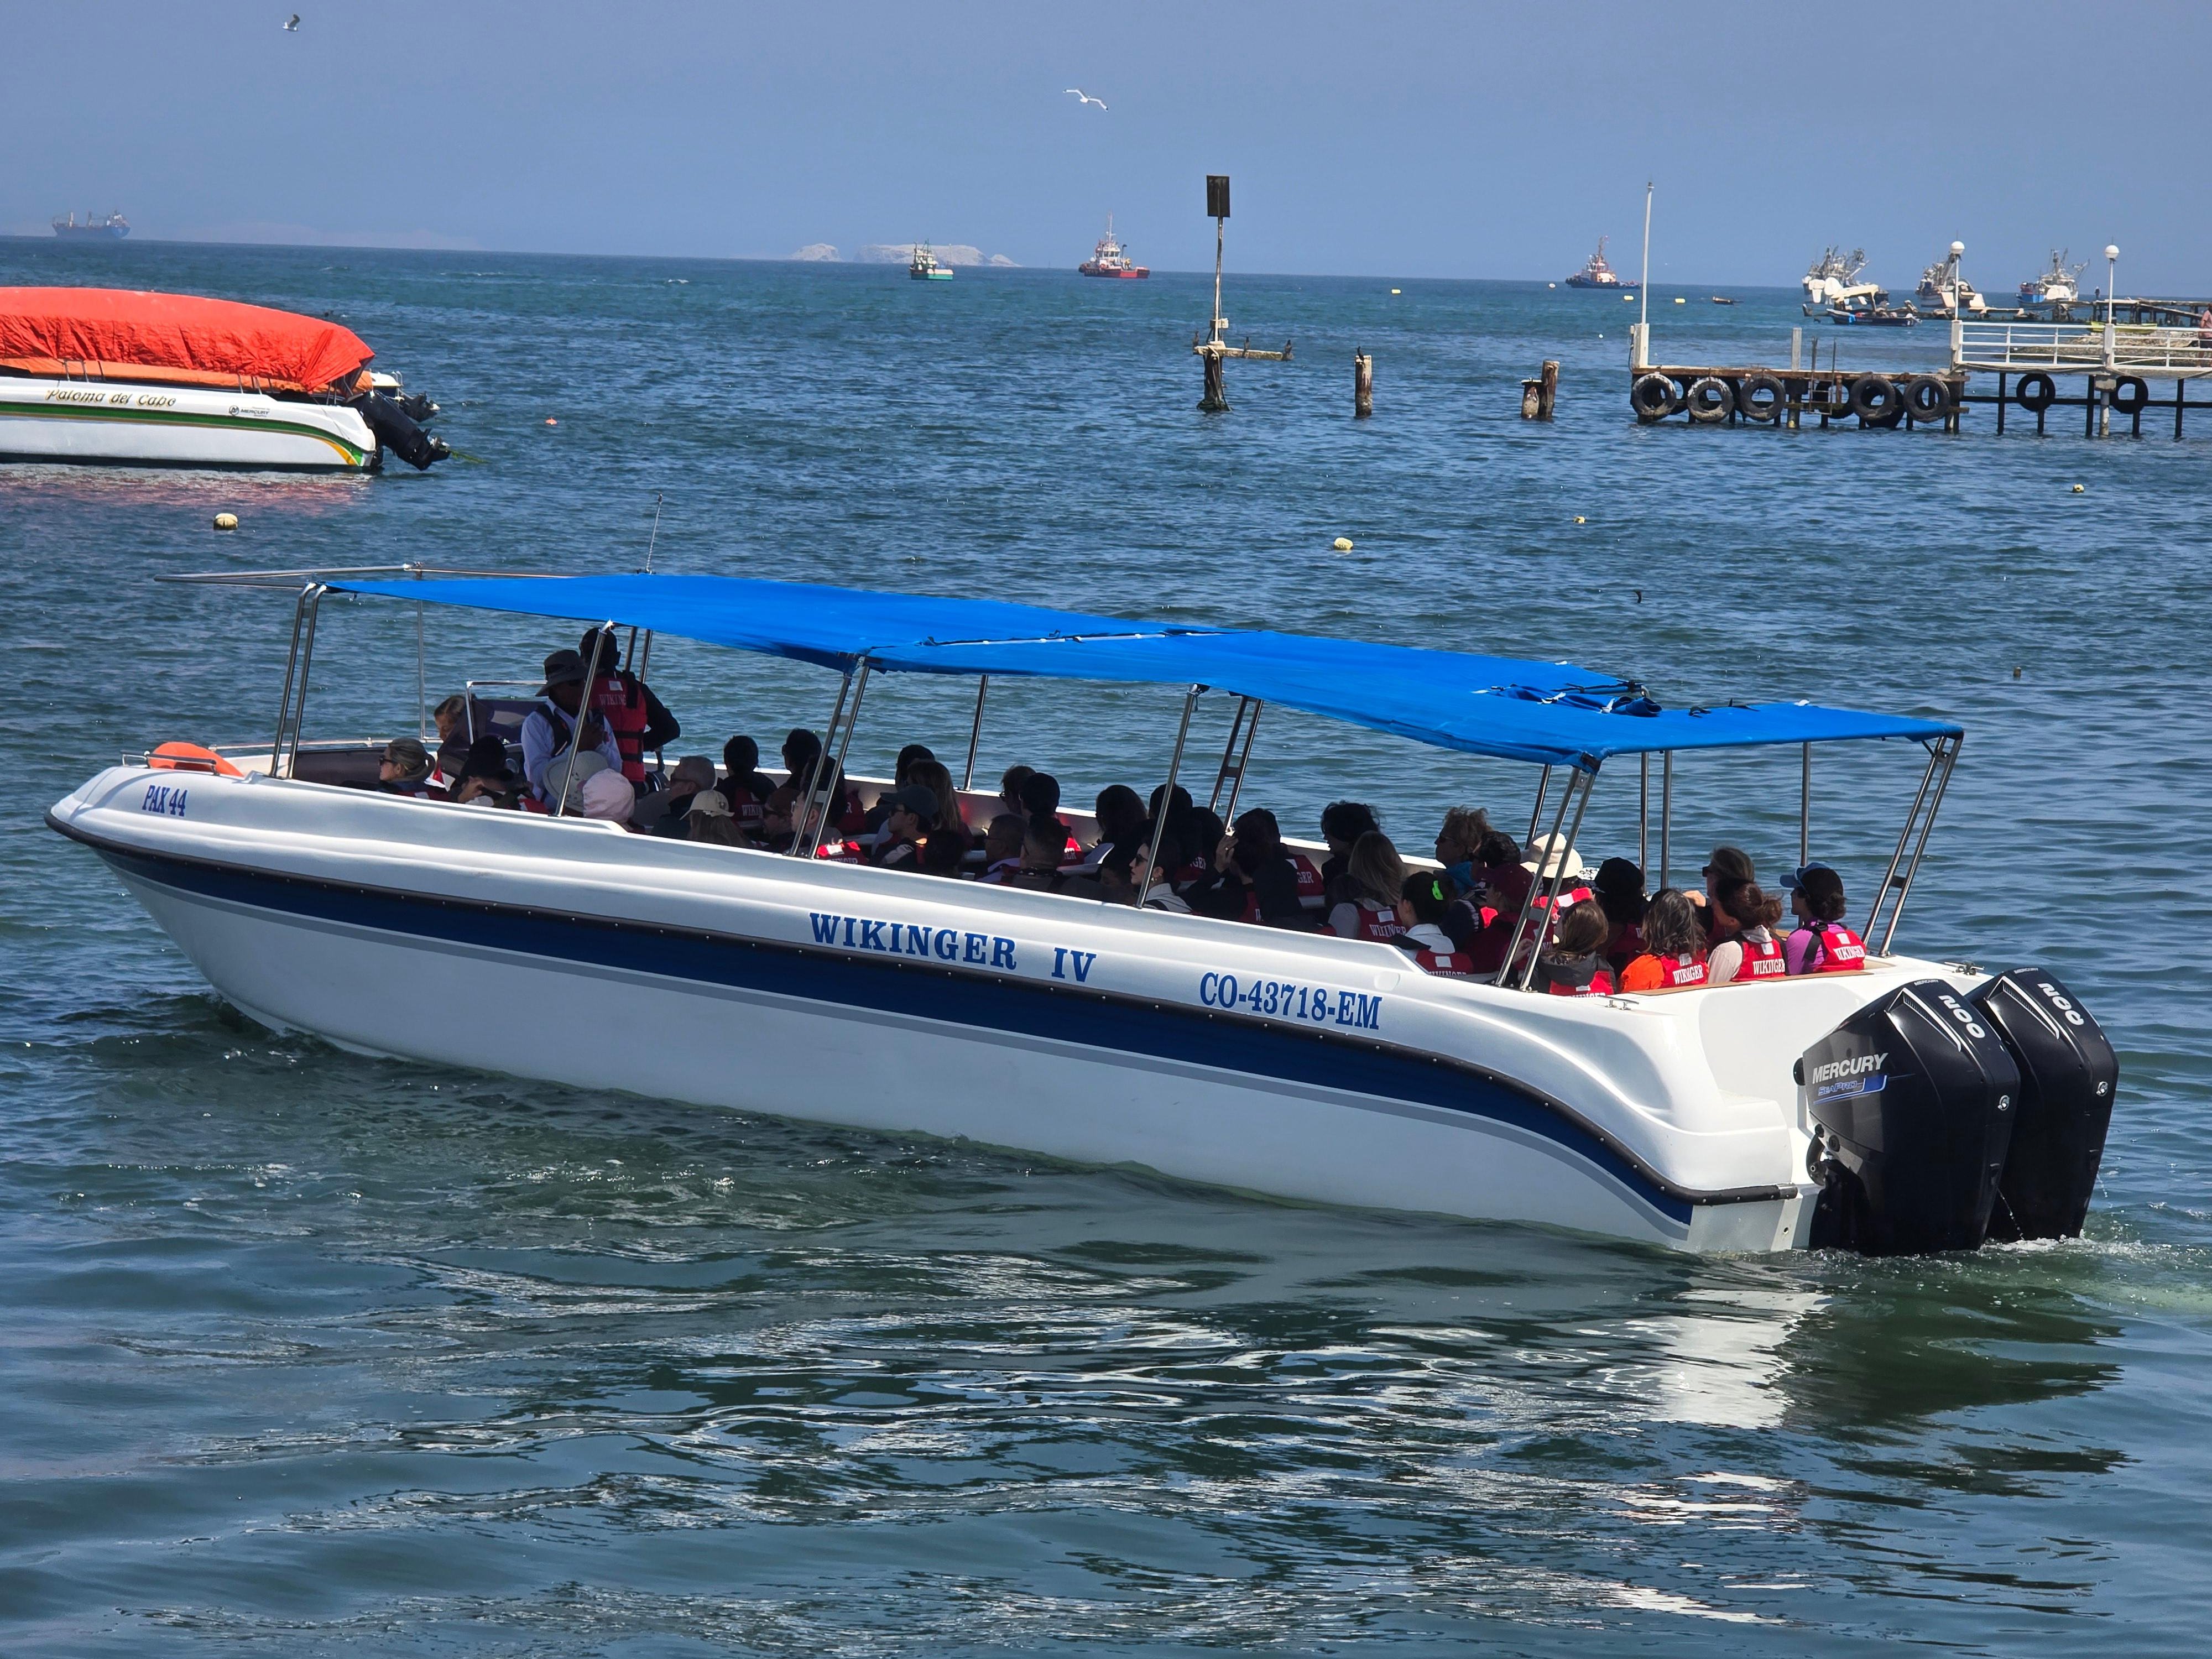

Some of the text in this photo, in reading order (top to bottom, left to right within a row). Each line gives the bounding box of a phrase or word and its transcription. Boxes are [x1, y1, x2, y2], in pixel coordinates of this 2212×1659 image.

[45, 389, 176, 407] Paloma del Cabo
[142, 784, 187, 817] PAX 44
[810, 912, 1097, 983] WIKINGER IV
[1672, 964, 1704, 985] WIKNGER
[1200, 972, 1383, 1030] CO-43718-EM
[1938, 995, 1986, 1039] 200
[2037, 983, 2084, 1025] 200
[1812, 1052, 1889, 1084] MERCURY
